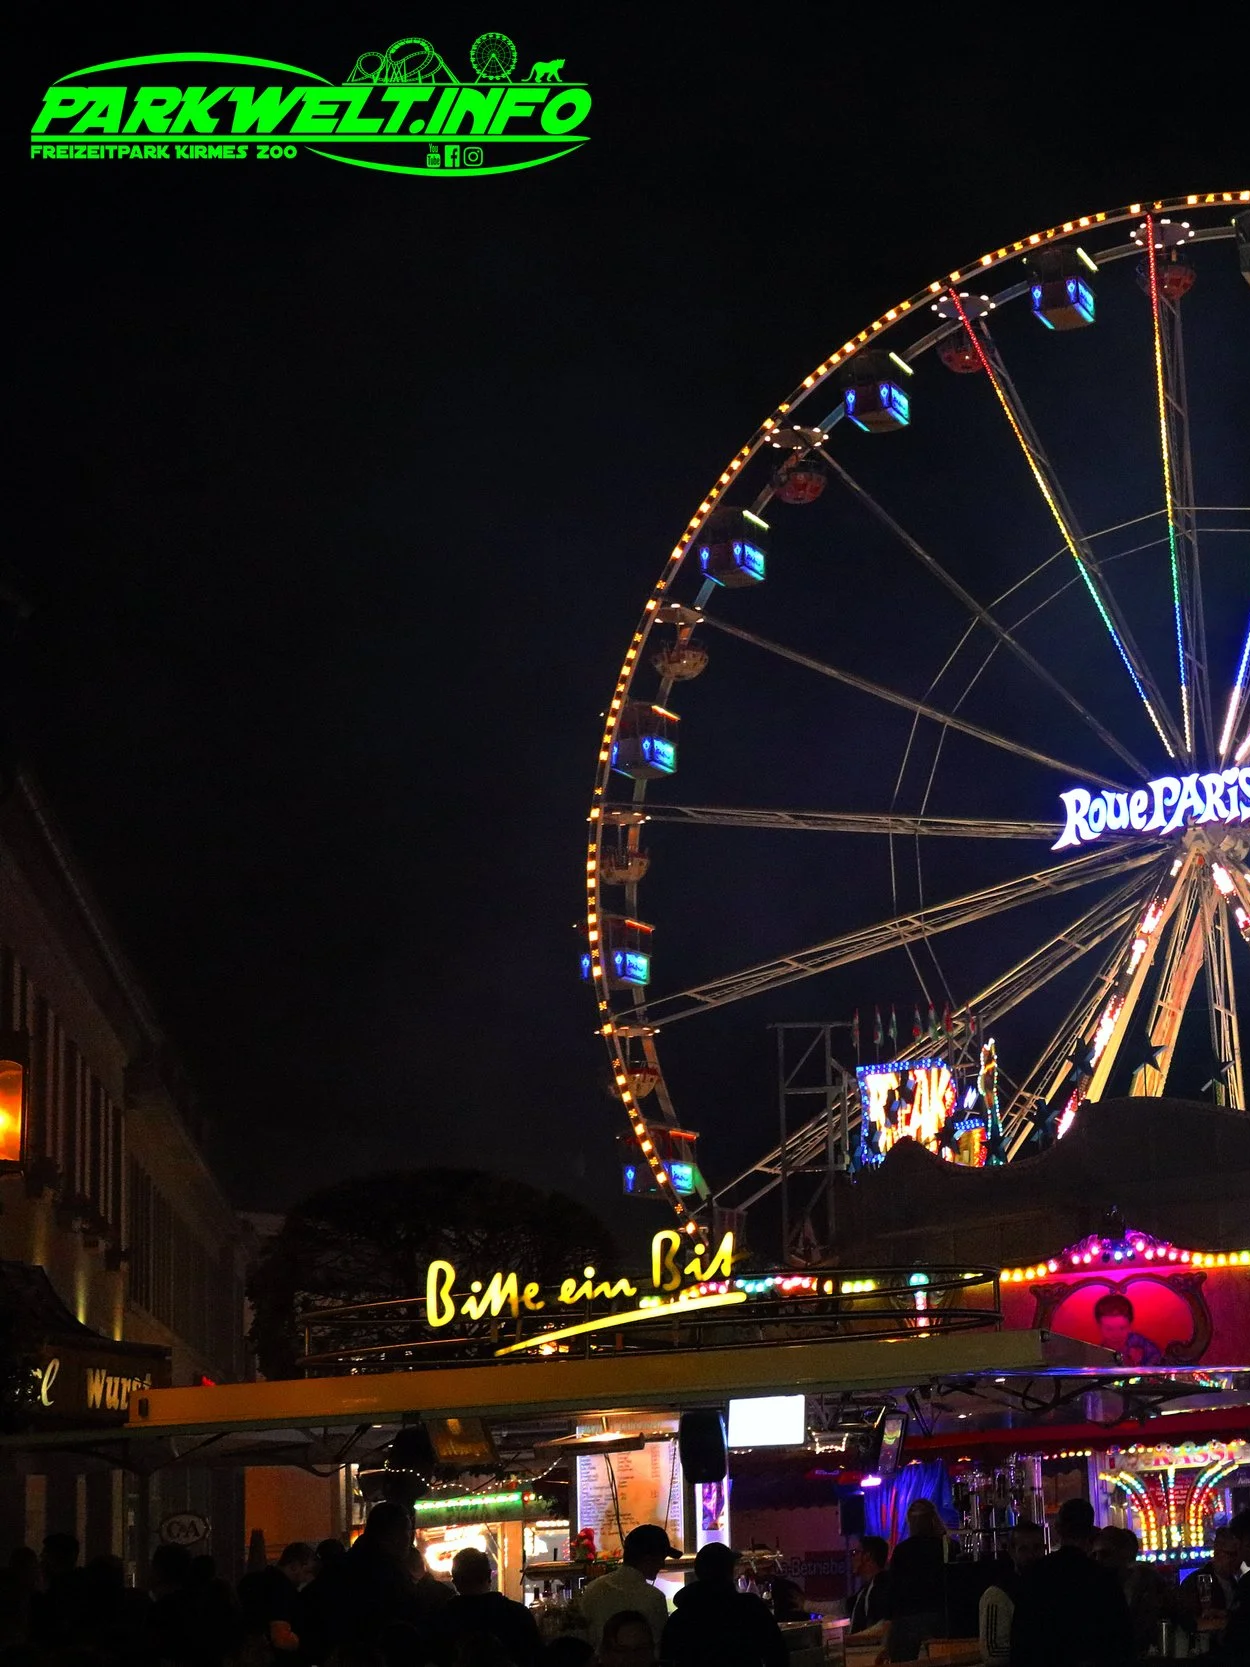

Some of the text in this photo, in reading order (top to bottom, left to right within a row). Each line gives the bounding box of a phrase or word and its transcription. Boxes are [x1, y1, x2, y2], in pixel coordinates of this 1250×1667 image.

[426, 1230, 748, 1327] Bitte ein Bit
